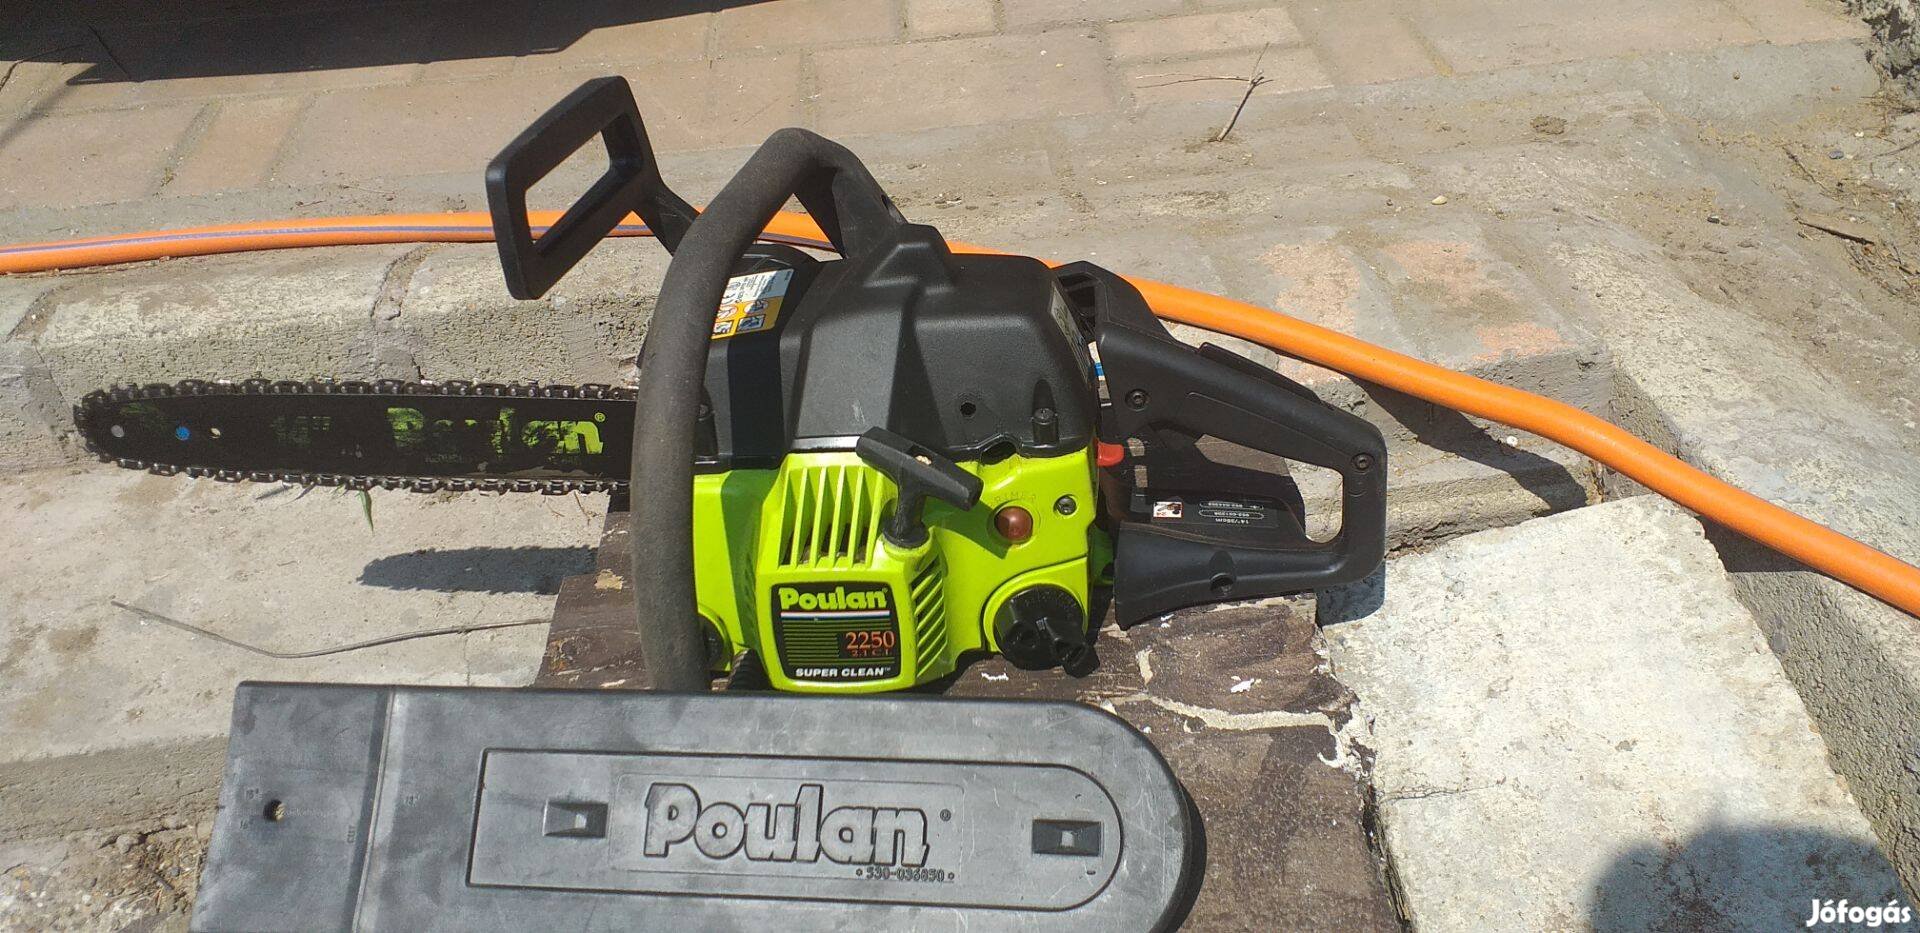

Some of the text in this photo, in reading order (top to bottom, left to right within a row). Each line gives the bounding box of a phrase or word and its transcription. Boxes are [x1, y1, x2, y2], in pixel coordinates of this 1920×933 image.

[778, 586, 887, 610] Poulan
[845, 630, 895, 650] 2250
[796, 668, 838, 677] SUPER
[643, 782, 930, 867] Poulan
